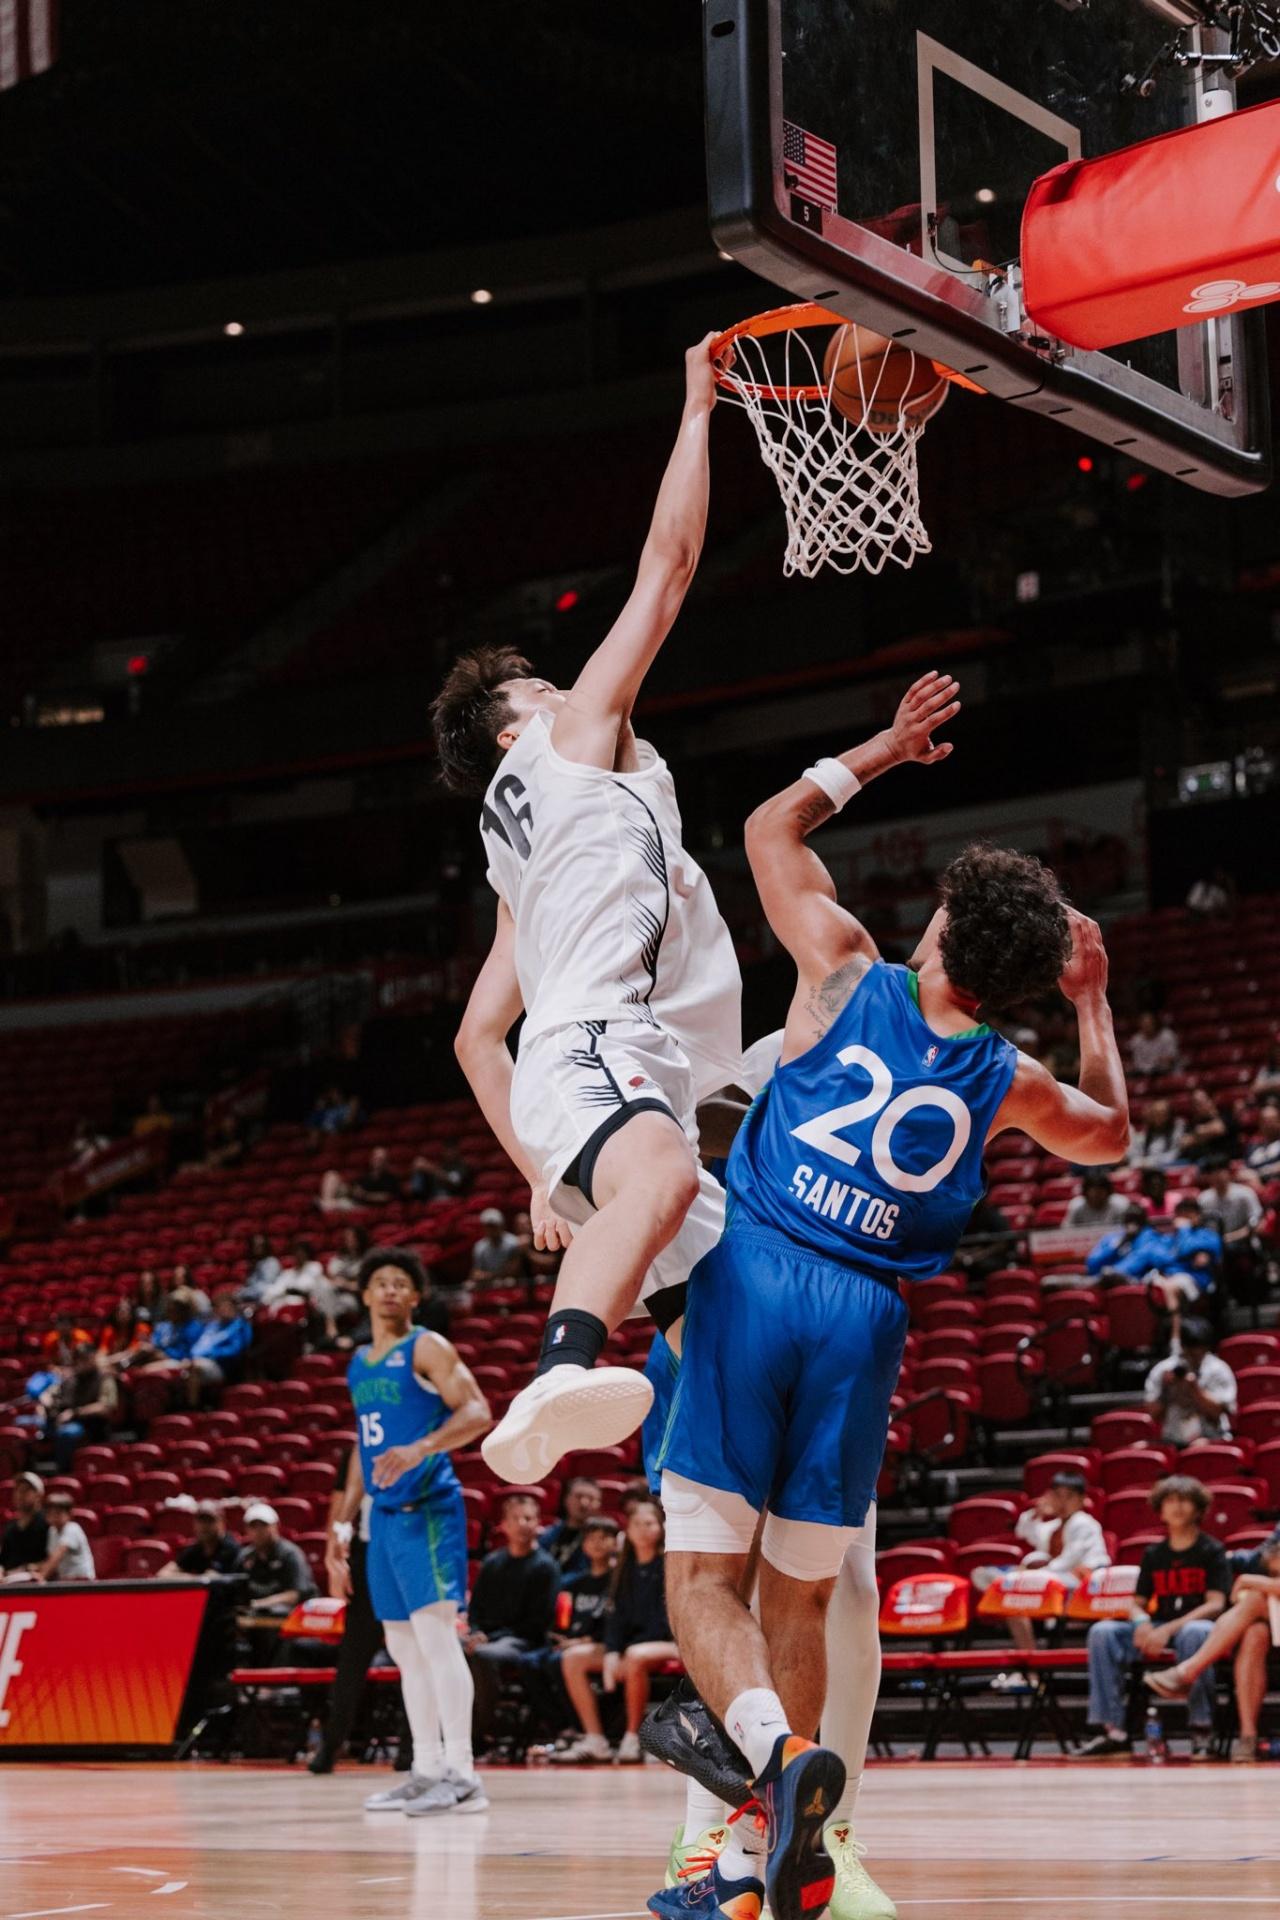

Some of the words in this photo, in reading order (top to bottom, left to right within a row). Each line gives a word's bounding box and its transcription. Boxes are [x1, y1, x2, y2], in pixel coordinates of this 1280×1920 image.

[803, 205, 810, 222] 5
[482, 774, 534, 861] 16
[790, 1044, 972, 1193] 20
[788, 1164, 901, 1240] SANTOS
[359, 1412, 385, 1448] 15
[0, 1611, 38, 1729] E
